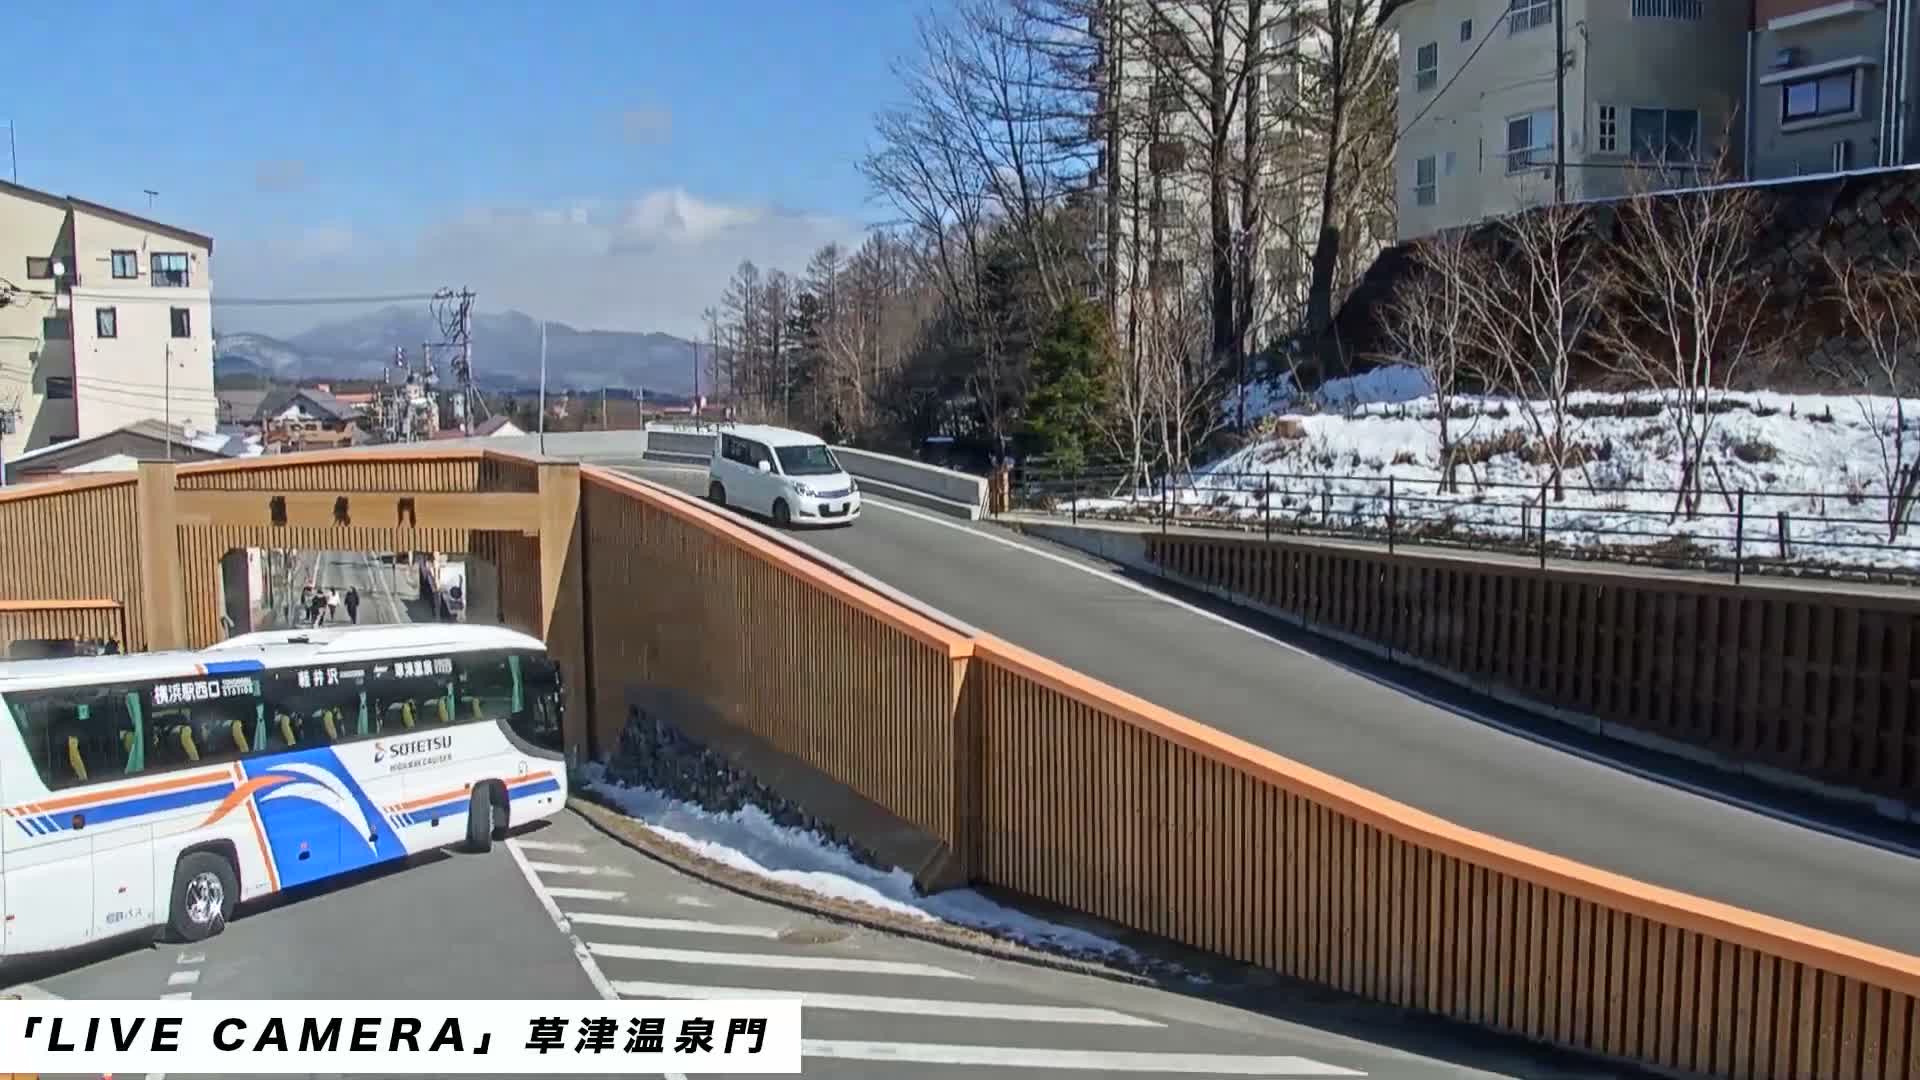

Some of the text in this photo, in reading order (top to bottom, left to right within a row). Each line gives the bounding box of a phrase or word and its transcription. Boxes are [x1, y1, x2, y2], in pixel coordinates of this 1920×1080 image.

[154, 681, 220, 705] 横浜駅西口
[390, 735, 453, 759] SOTETSU
